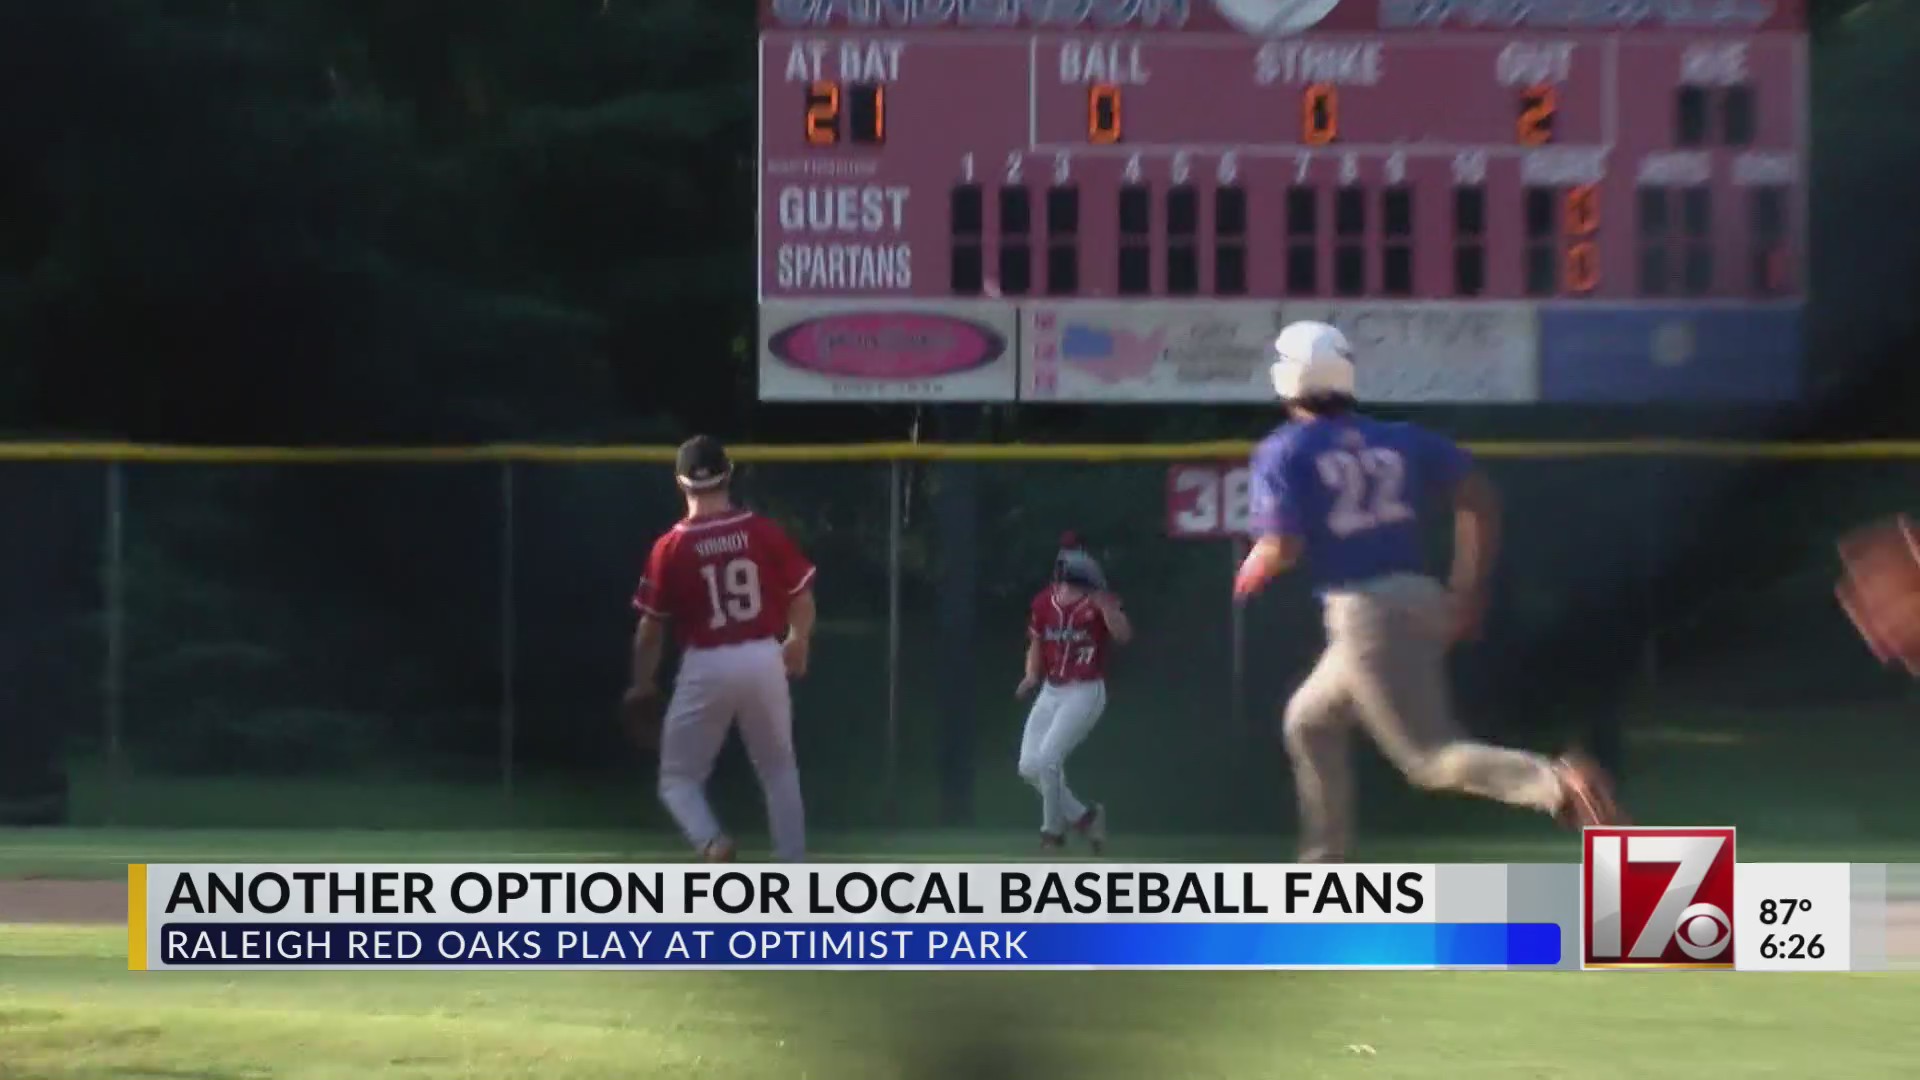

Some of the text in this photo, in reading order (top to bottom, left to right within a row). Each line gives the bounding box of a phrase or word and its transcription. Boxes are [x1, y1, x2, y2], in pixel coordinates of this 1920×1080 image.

[785, 40, 905, 82] AT BAT
[1059, 42, 1150, 85] BALL
[1255, 40, 1385, 87] STRIKE
[806, 82, 886, 145] 21
[1088, 83, 1122, 145] 0
[1302, 82, 1338, 146] 0
[1515, 83, 1557, 146] 2
[961, 151, 974, 185] 1
[1006, 150, 1024, 185] 2
[1054, 150, 1071, 185] 3
[1125, 151, 1143, 185] 4
[778, 185, 910, 233] GUEST
[777, 242, 912, 290] SPARTANS
[1316, 446, 1415, 539] 22
[700, 557, 762, 630] 19
